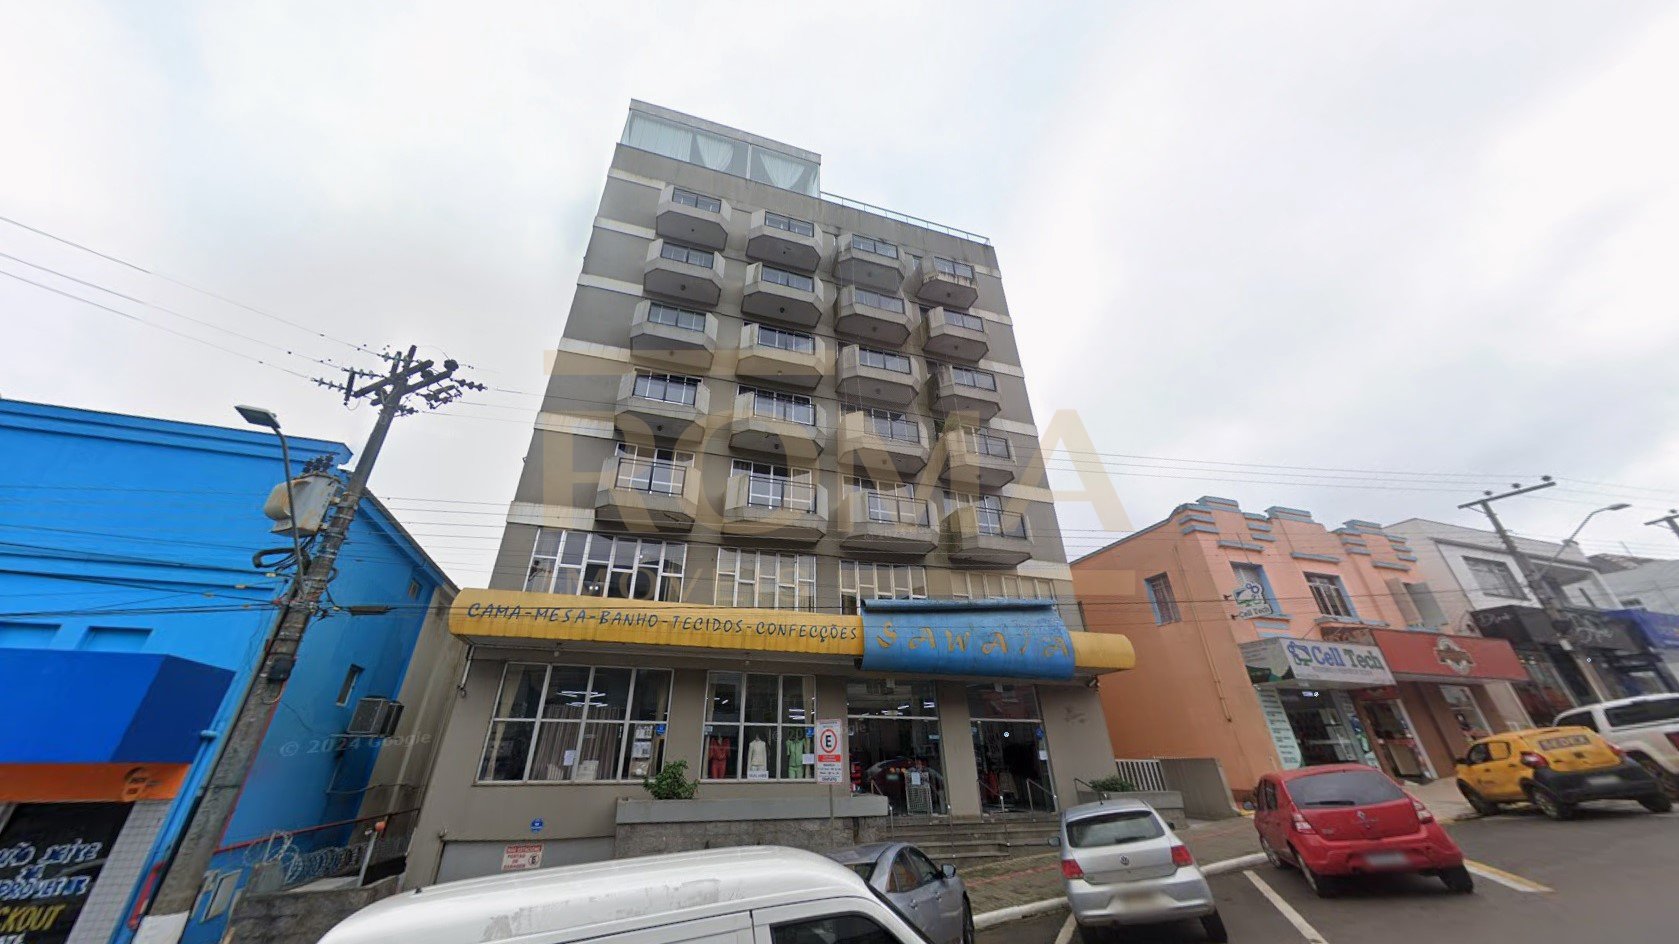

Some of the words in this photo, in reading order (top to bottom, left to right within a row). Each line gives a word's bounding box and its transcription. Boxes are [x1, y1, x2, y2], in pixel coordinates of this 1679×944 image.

[1311, 645, 1345, 667] Cell
[1343, 648, 1384, 670] Tech
[825, 735, 832, 748] E
